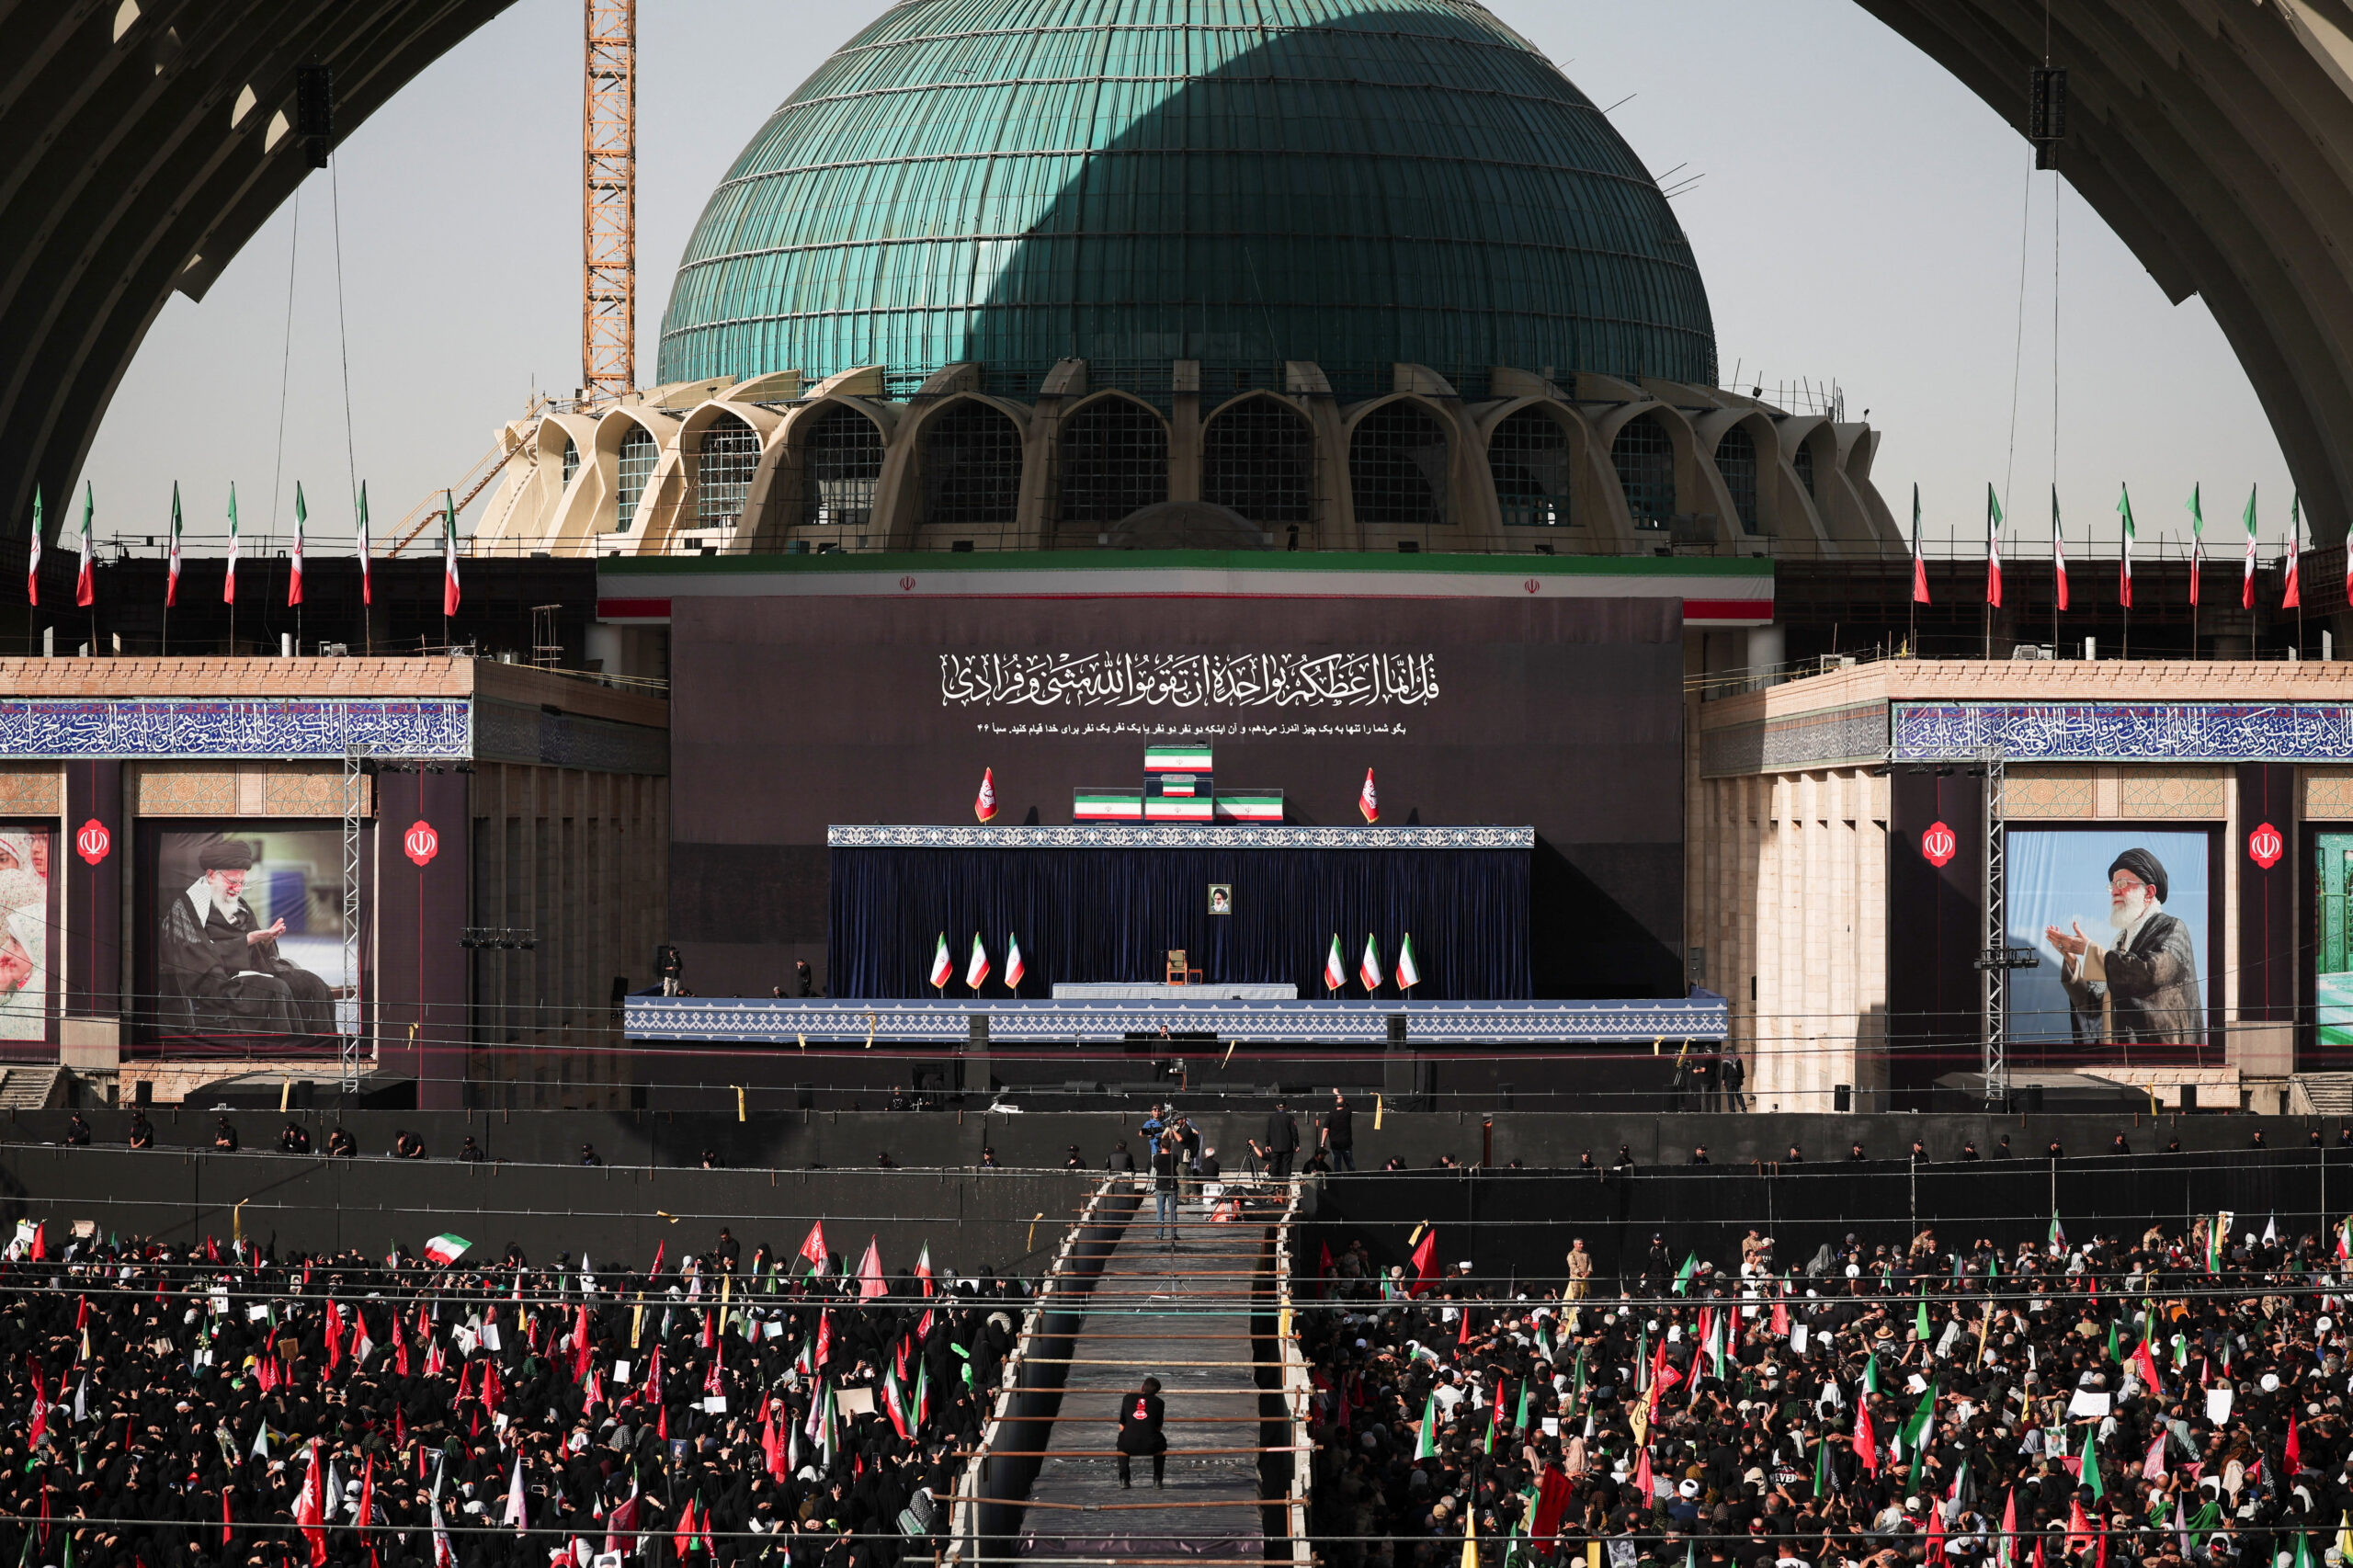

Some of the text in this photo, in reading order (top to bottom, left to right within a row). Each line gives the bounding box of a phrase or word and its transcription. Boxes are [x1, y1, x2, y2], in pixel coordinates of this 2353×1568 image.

[1028, 722, 1044, 736] قیام
[1044, 722, 1059, 734] خدا
[1060, 723, 1080, 735] برای
[1081, 722, 1095, 735] نفر
[1095, 722, 1111, 734] یک
[1111, 722, 1126, 734] نفر
[1126, 722, 1142, 734] یک
[1142, 722, 1151, 735] یا
[1152, 723, 1165, 735] نفر
[1166, 724, 1177, 735] دو
[1177, 722, 1192, 735] نفر
[1194, 724, 1204, 735] دو
[1204, 723, 1226, 735] اینکه
[1227, 722, 1238, 735] آن
[1239, 725, 1247, 735] و
[1279, 723, 1301, 735] اندرز
[1301, 723, 1317, 736] چیز
[1317, 723, 1334, 735] یک
[1334, 723, 1345, 735] به
[1345, 723, 1361, 735] تنها
[1361, 723, 1372, 735] را
[1372, 722, 1390, 734] شما
[1390, 722, 1407, 736] بگو
